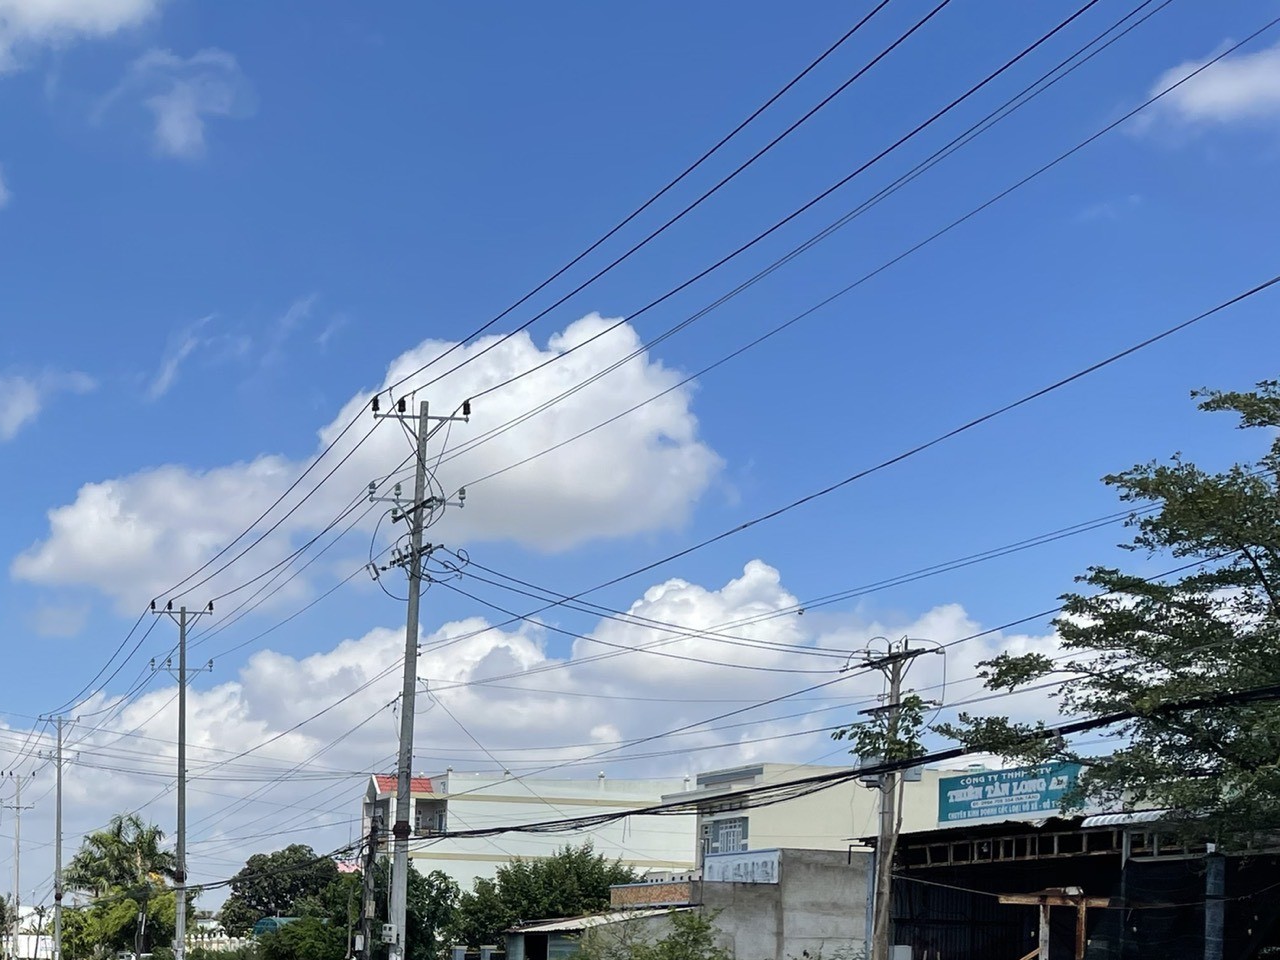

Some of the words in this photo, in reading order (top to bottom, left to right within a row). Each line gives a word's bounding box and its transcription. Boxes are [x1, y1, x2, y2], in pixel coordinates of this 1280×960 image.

[960, 777, 985, 786] CÔNG
[987, 774, 999, 782] TY
[1012, 778, 1047, 795] LONG
